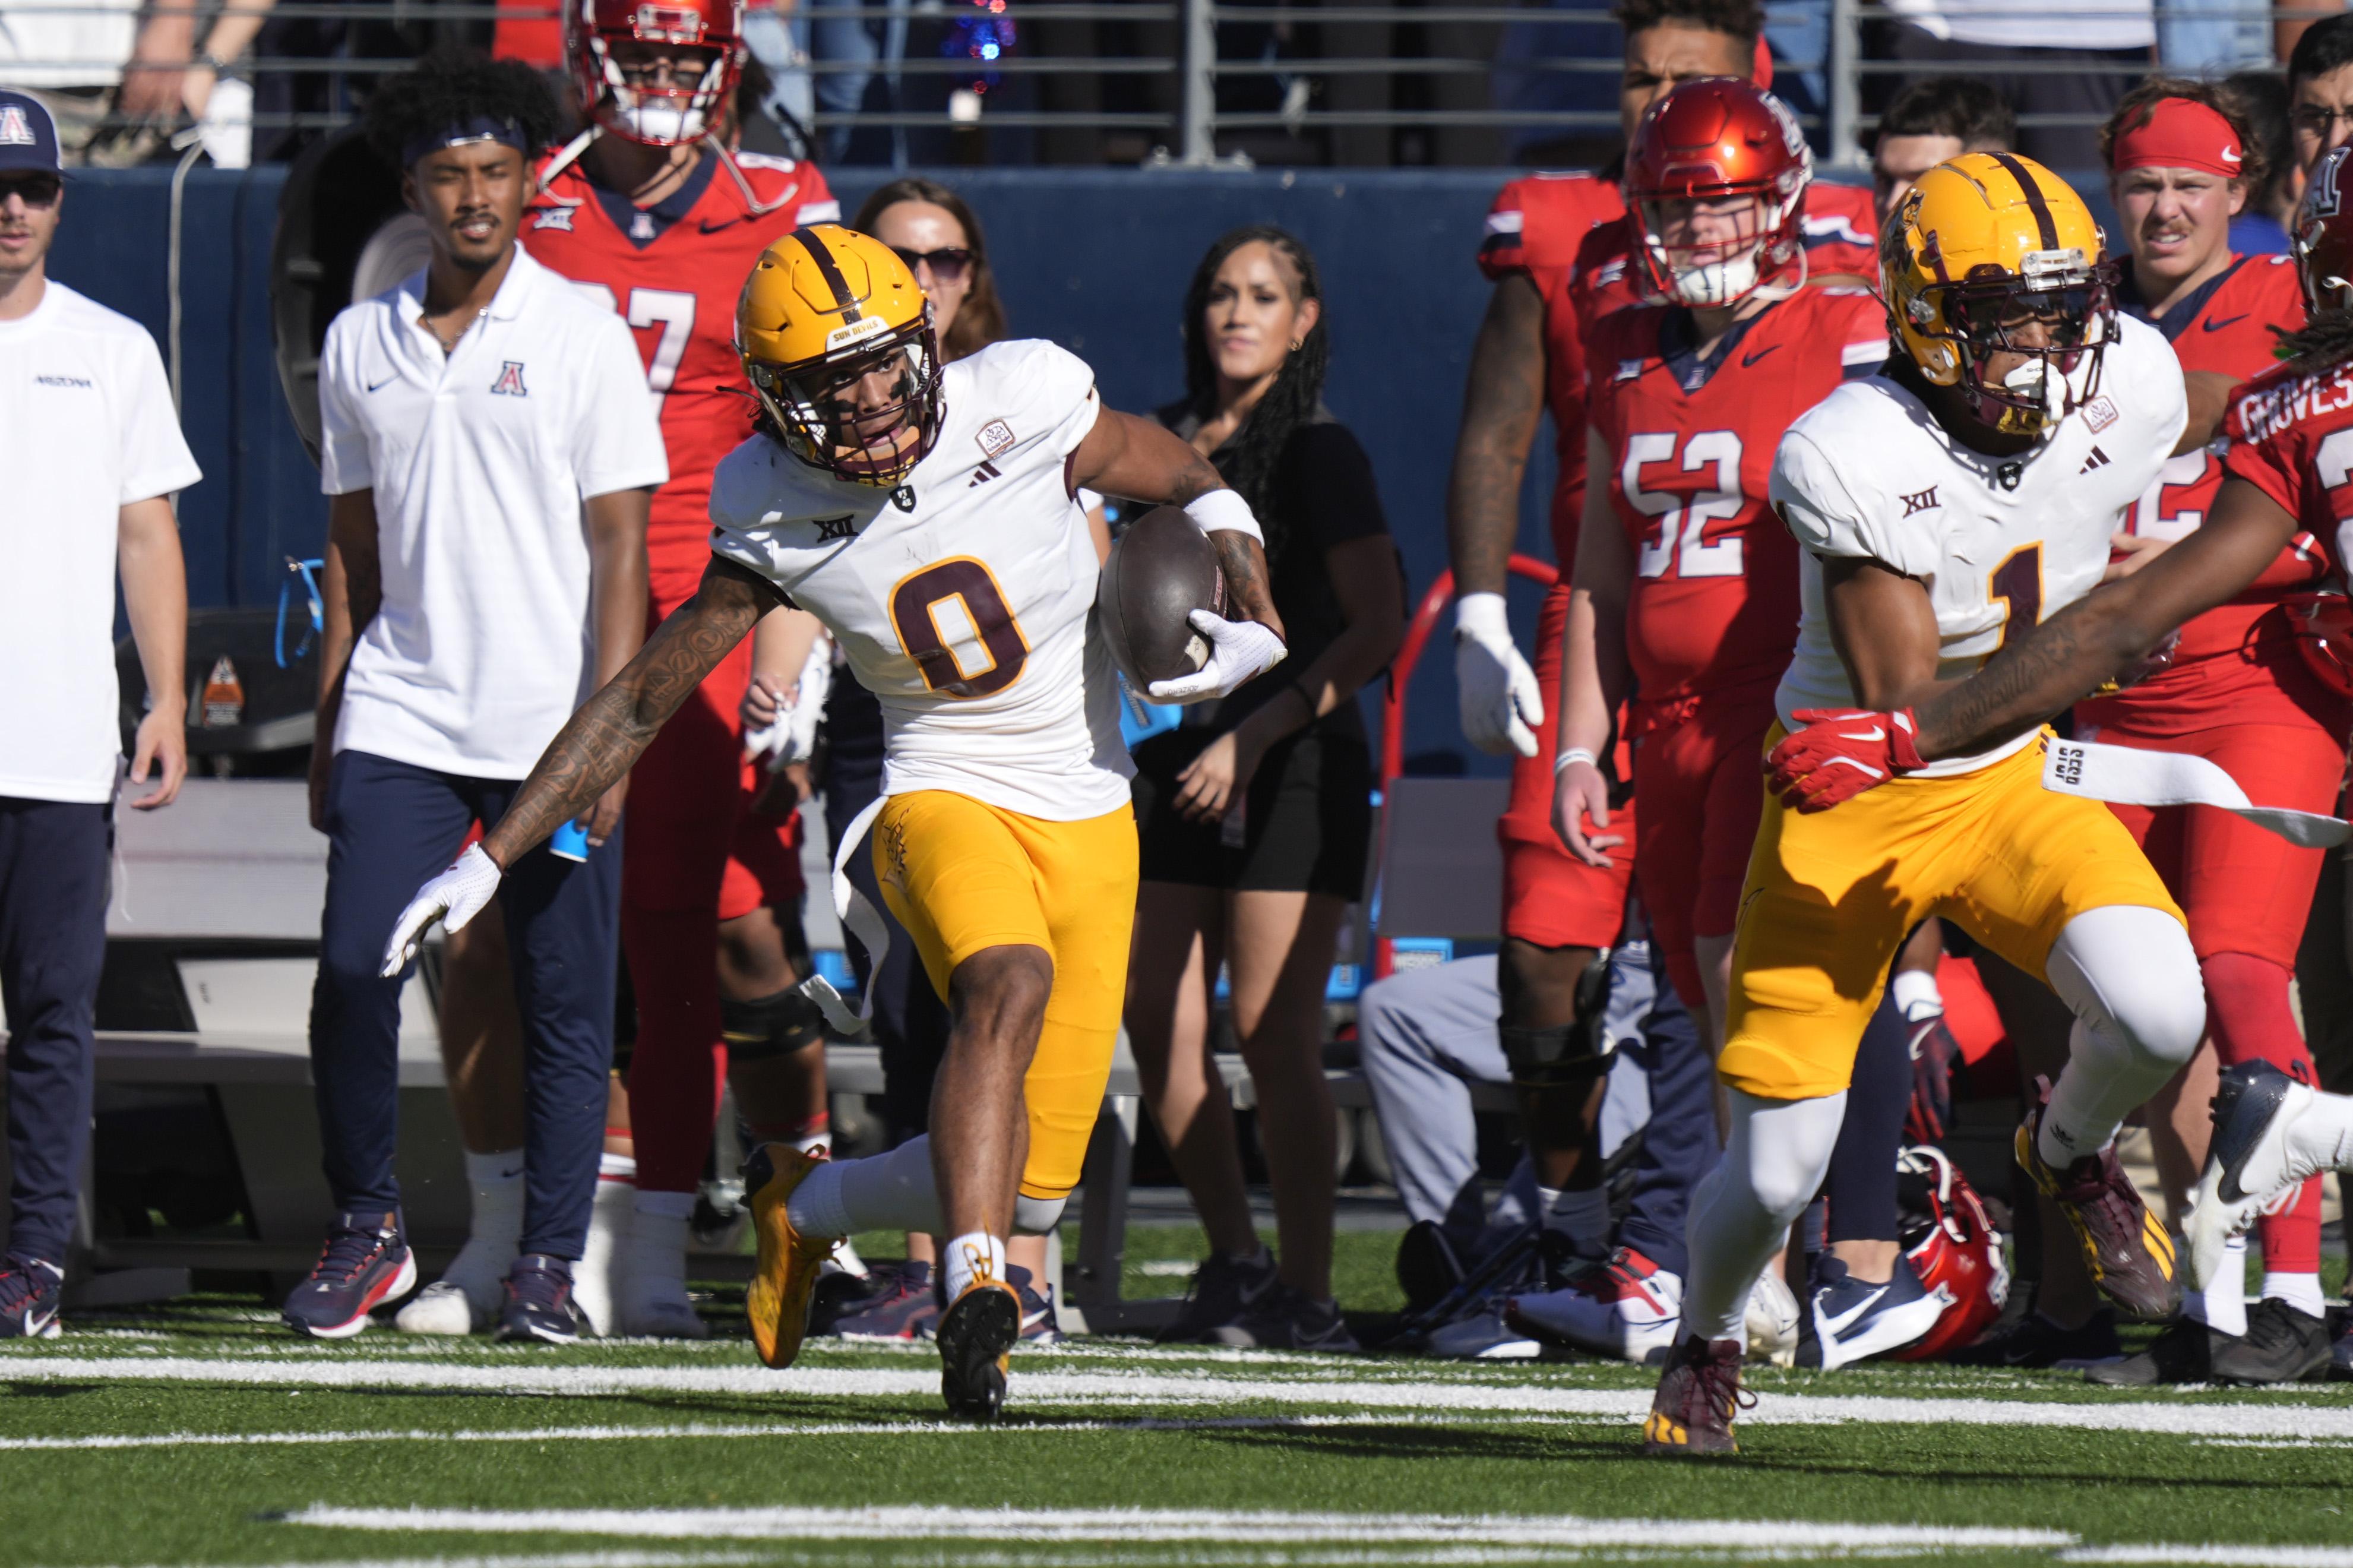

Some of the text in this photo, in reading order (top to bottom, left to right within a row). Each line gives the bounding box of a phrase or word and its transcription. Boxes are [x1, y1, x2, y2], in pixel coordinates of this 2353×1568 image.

[833, 320, 878, 342] SUN DEVILS
[34, 374, 93, 390] ARIZONA
[491, 360, 527, 397] A
[1622, 429, 1745, 579] 52
[1899, 485, 1942, 519] XII
[812, 514, 861, 544] XII
[1987, 539, 2045, 650] 1
[887, 554, 1032, 701] 0
